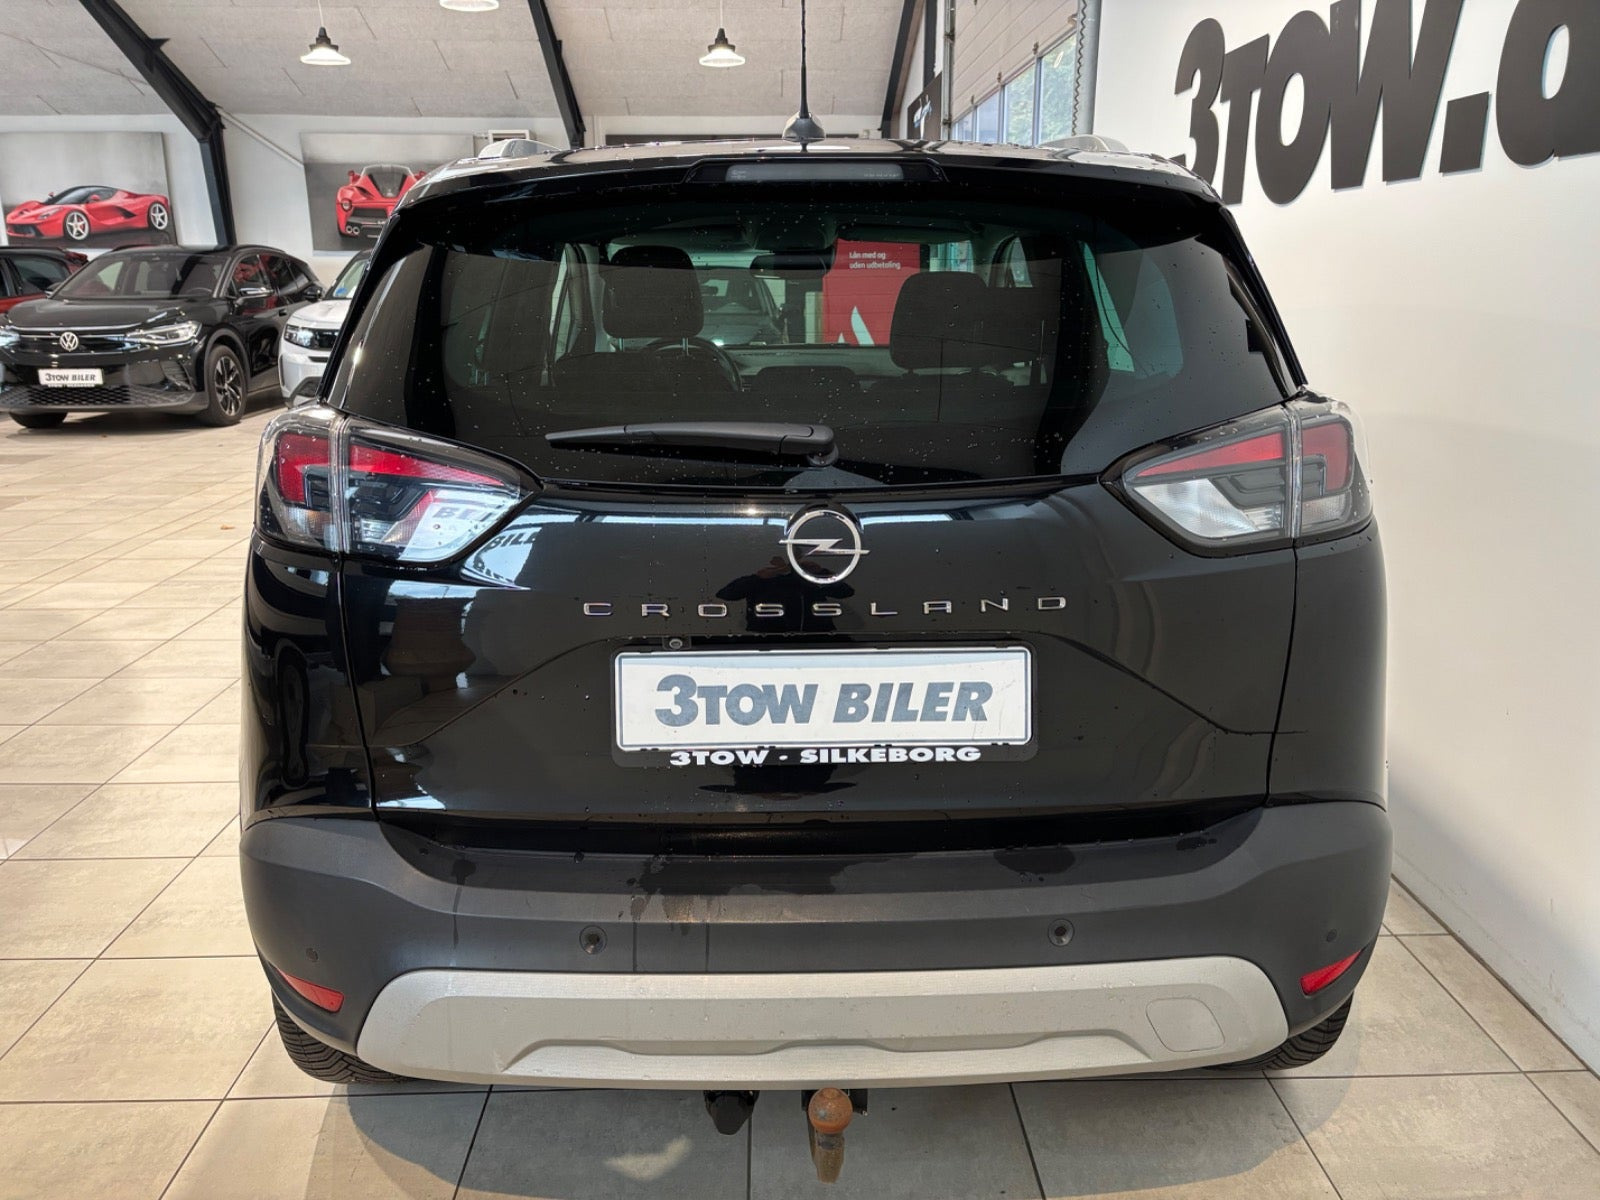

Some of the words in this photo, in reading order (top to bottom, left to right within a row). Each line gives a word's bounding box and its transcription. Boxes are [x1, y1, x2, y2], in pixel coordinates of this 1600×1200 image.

[877, 252, 886, 260] og
[866, 261, 901, 270] udbetaling
[45, 373, 69, 381] 3TOW
[583, 595, 1067, 618] CROSSLAND
[654, 673, 818, 728] 3TOW
[832, 680, 994, 724] BILER
[669, 749, 769, 766] 3TOW
[799, 746, 982, 764] SILKEBORG
